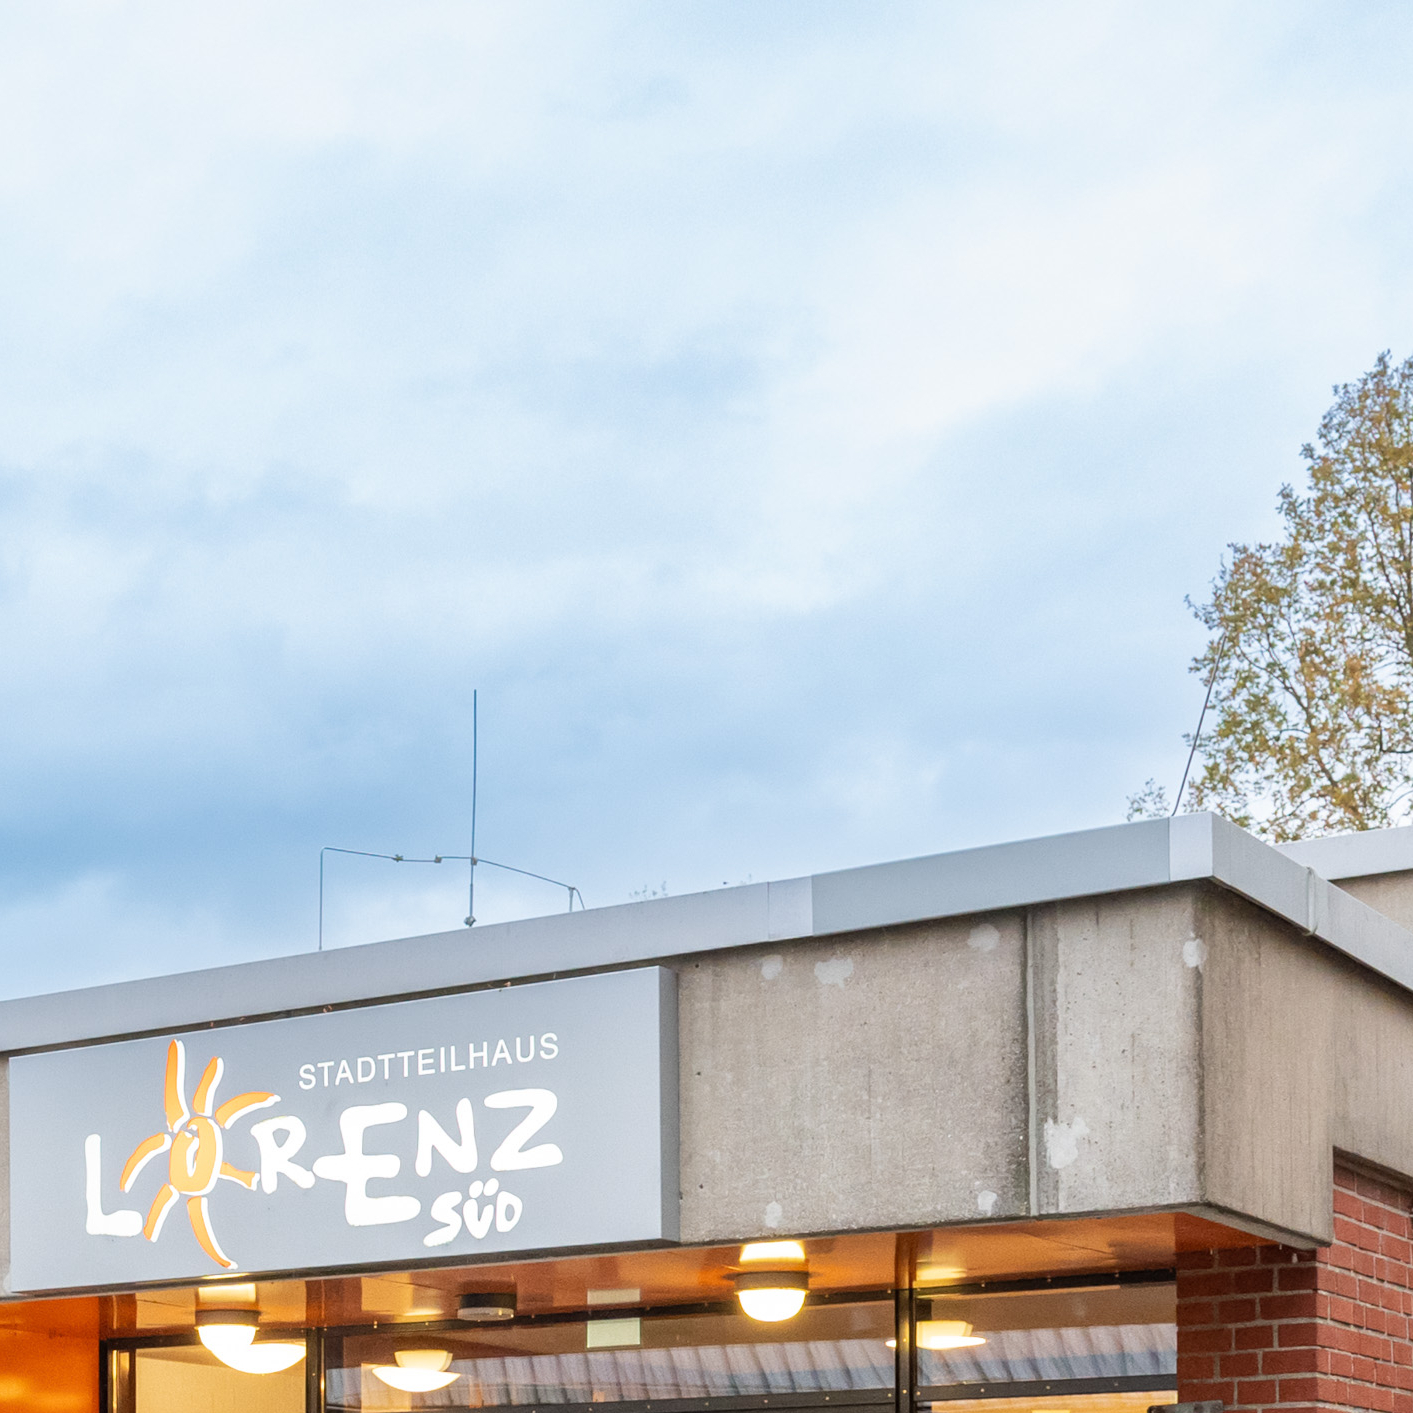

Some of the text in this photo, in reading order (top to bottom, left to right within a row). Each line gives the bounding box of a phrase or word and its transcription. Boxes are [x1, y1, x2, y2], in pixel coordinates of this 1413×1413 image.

[298, 1032, 560, 1090] STADTTEILHAUS
[85, 1088, 563, 1236] LORENZ
[423, 1178, 523, 1247] SÜD
